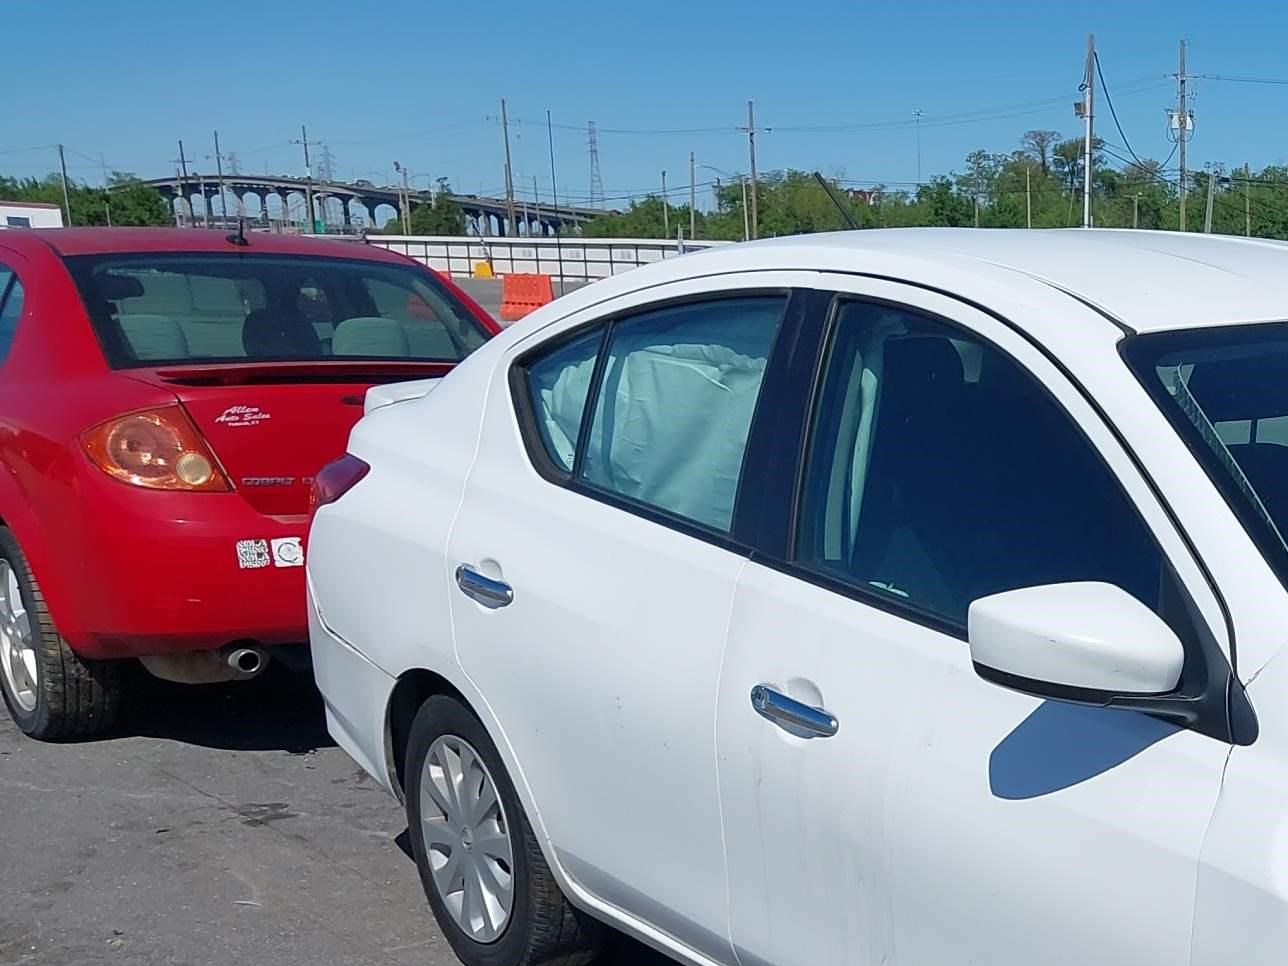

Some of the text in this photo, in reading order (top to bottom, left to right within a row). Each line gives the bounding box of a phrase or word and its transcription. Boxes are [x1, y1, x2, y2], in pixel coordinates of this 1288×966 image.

[214, 412, 271, 423] Auto Sales
[242, 477, 296, 486] COBALT
